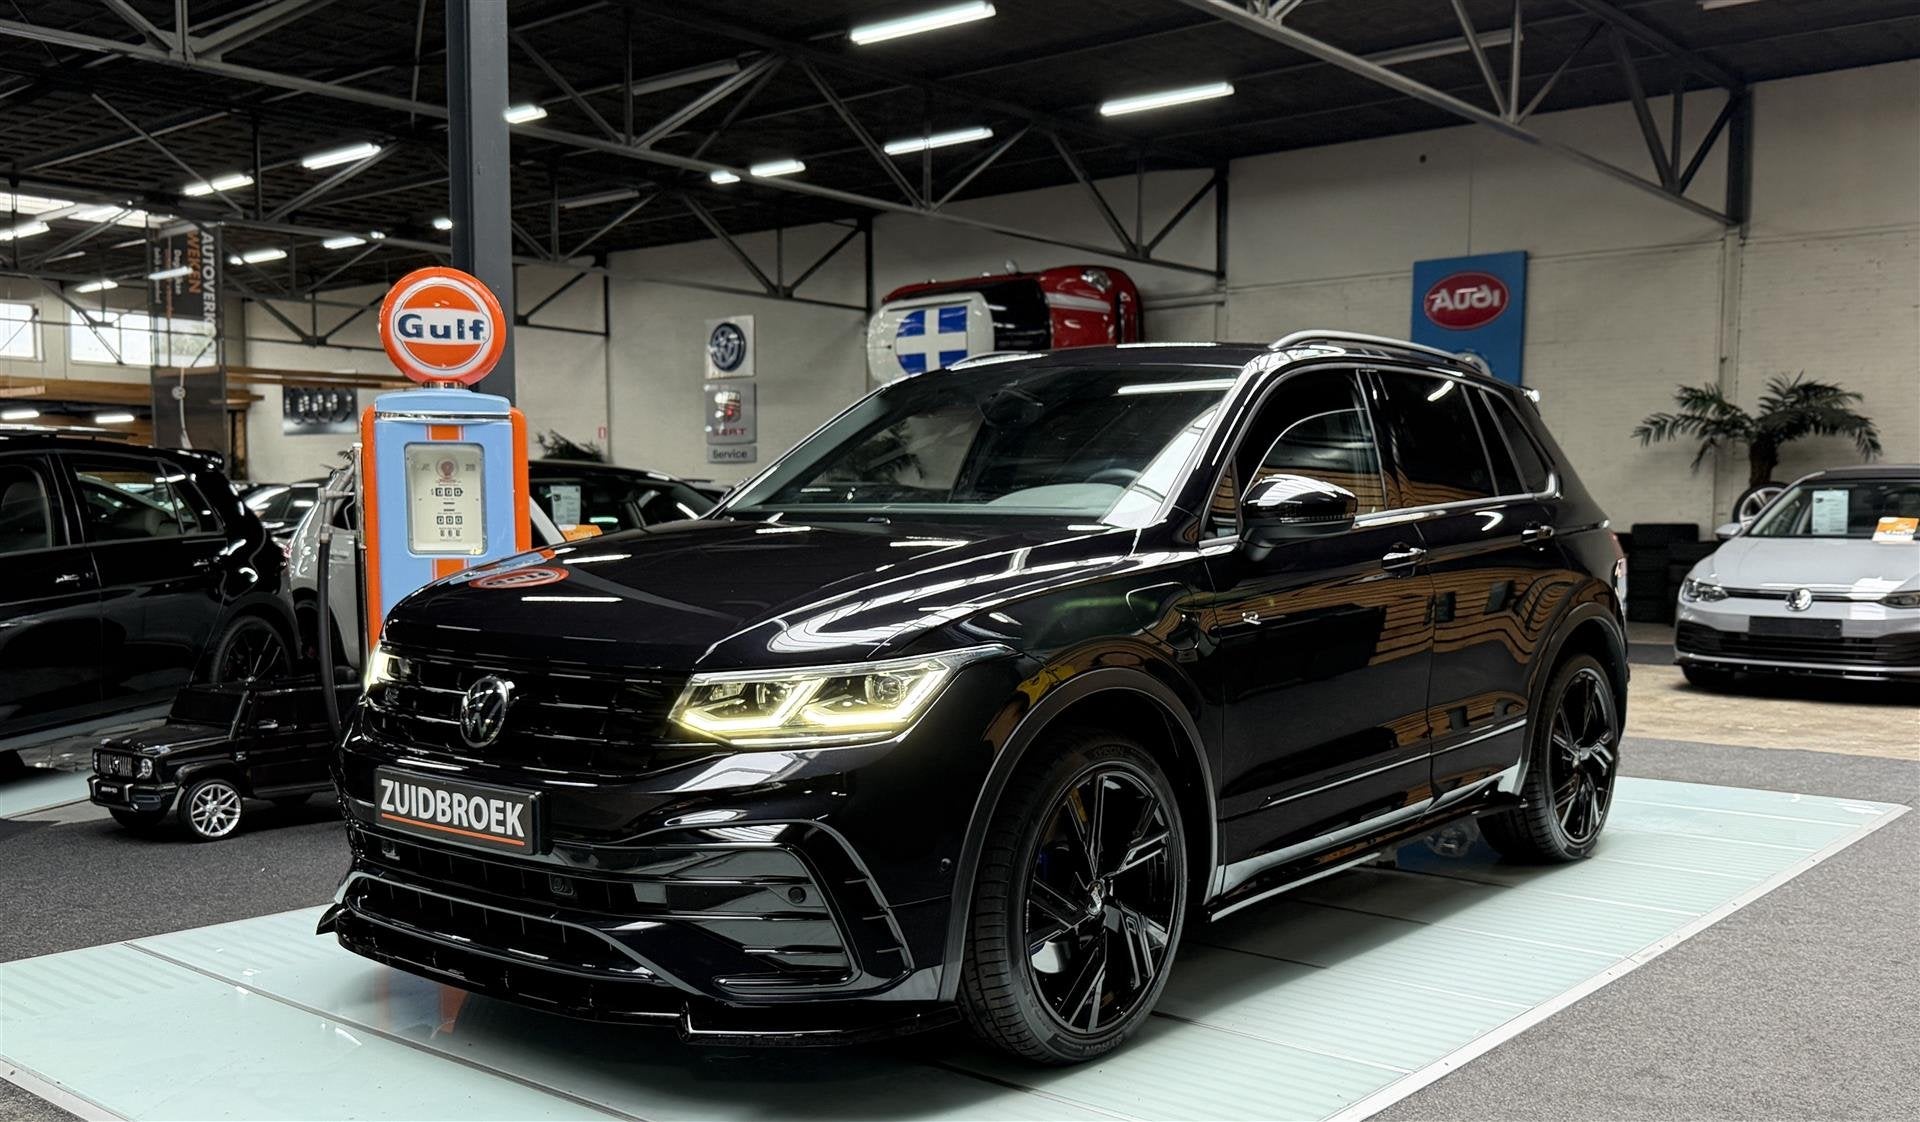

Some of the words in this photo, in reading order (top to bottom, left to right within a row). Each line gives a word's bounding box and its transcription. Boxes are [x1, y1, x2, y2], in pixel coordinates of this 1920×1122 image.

[397, 313, 486, 341] Gulf
[713, 449, 748, 459] Service
[380, 779, 525, 838] ZUIDBROEK
